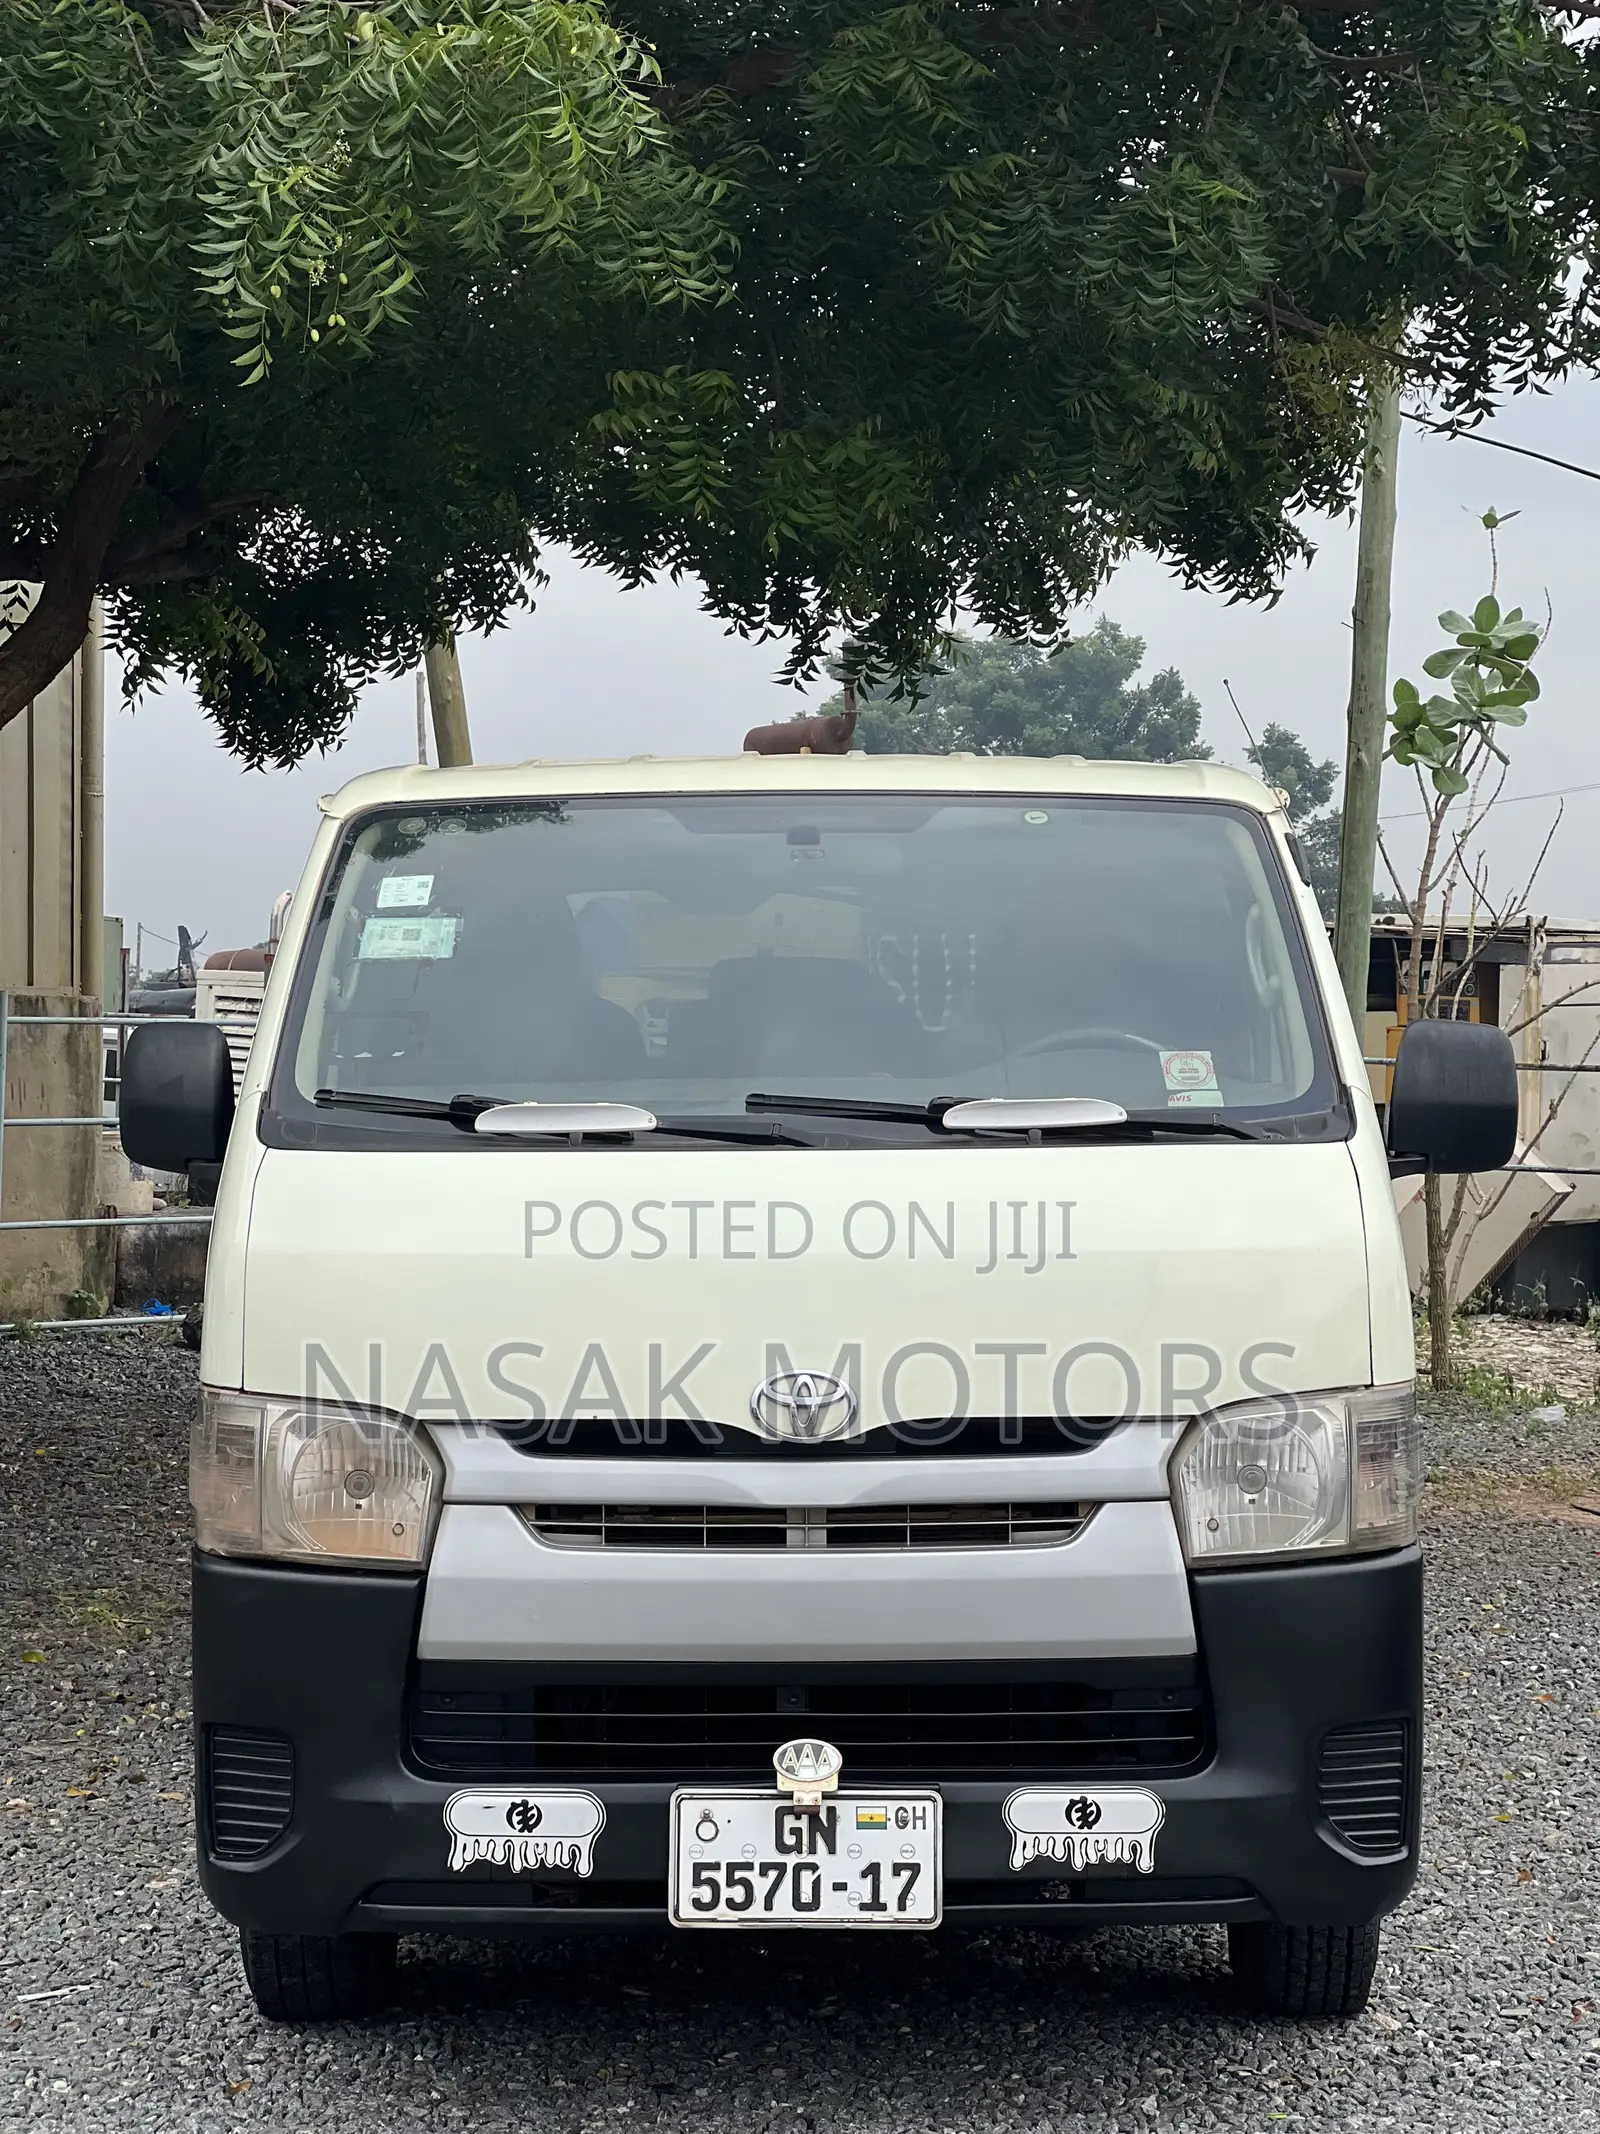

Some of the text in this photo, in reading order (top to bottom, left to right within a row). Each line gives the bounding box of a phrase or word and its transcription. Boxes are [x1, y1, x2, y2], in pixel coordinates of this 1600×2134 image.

[782, 1743, 832, 1775] AAA
[775, 1806, 837, 1855] GN
[894, 1806, 926, 1830] GH
[692, 1862, 921, 1912] 5570-17
